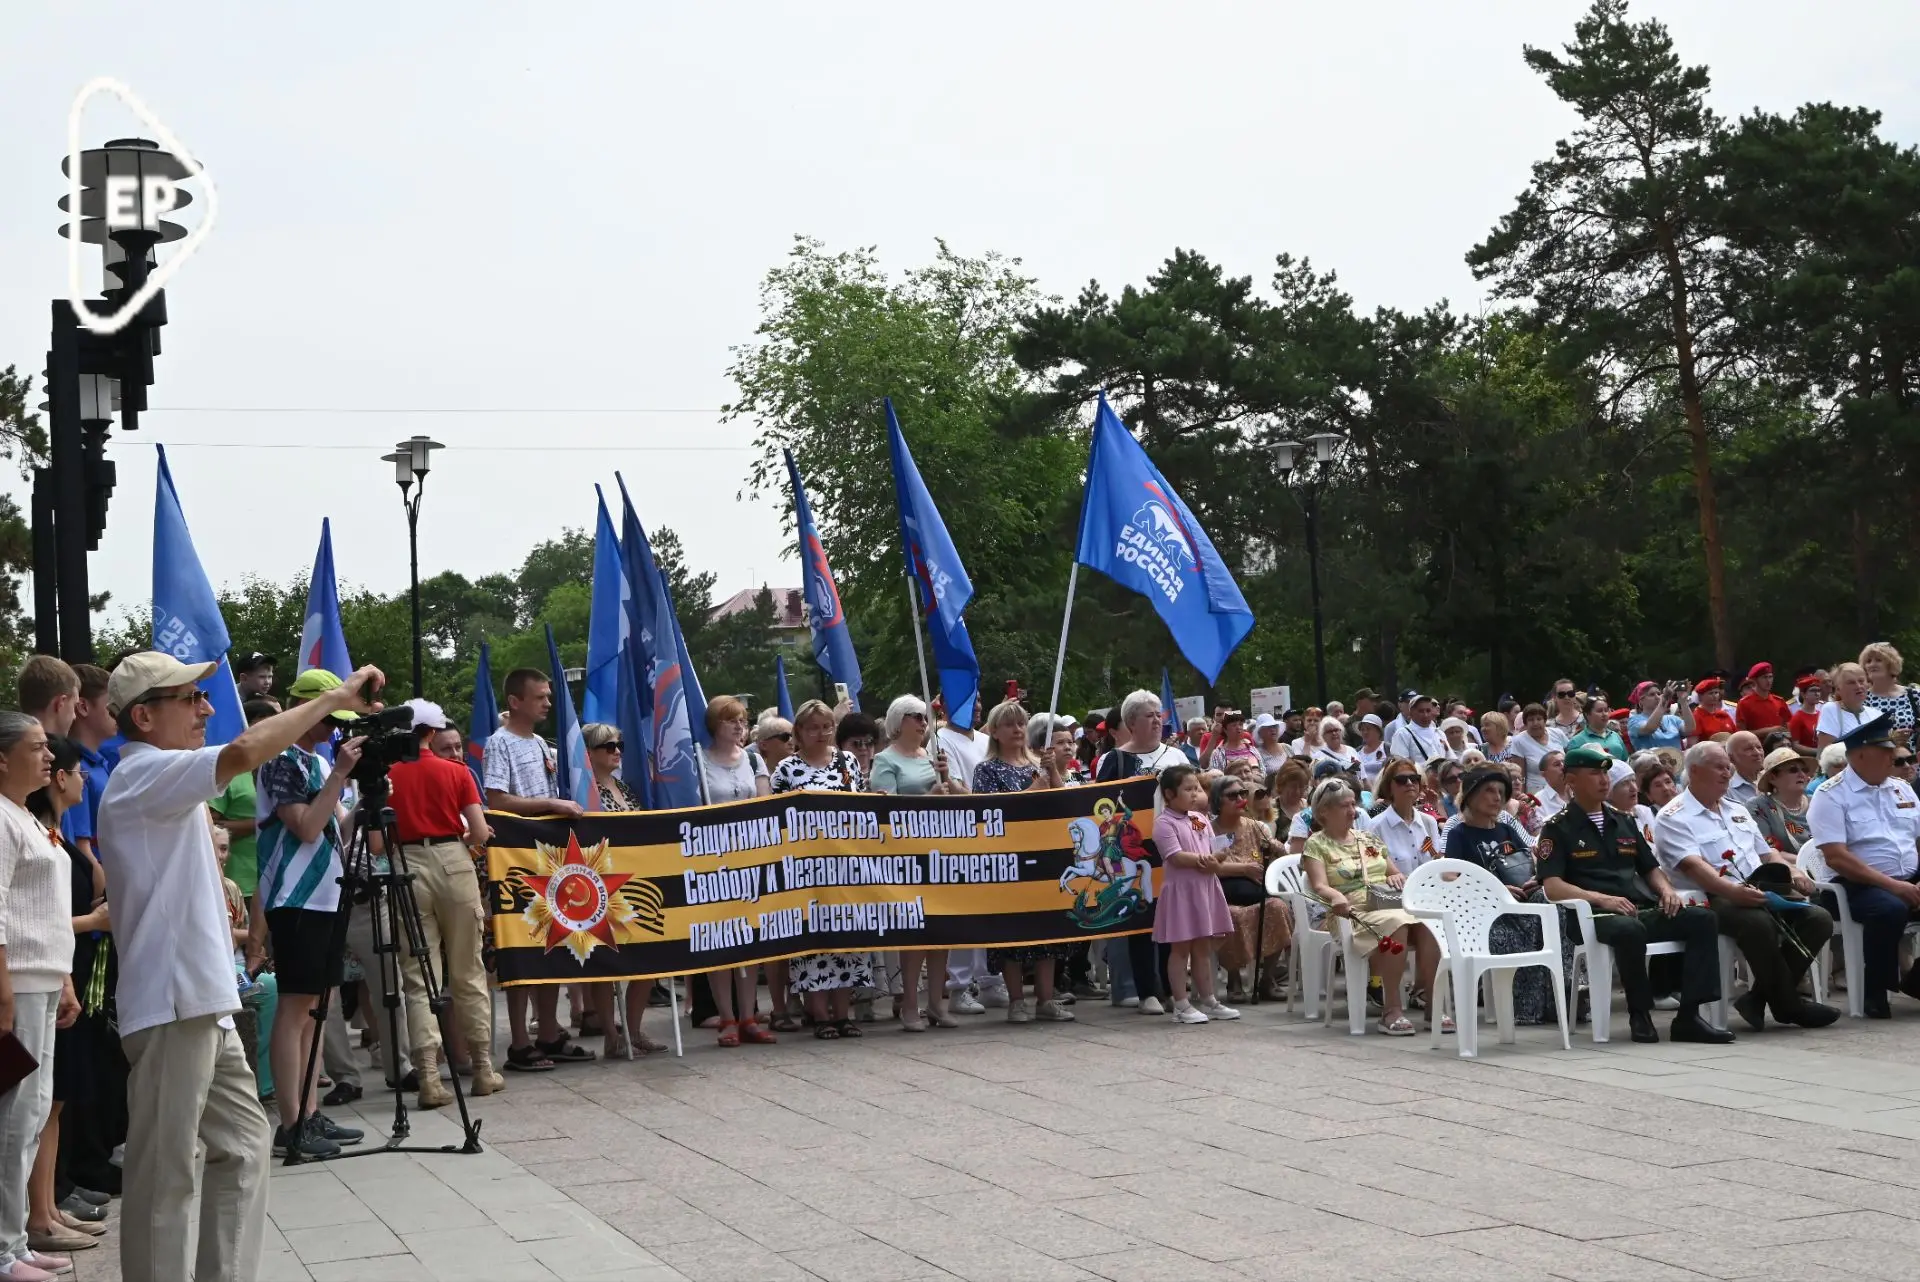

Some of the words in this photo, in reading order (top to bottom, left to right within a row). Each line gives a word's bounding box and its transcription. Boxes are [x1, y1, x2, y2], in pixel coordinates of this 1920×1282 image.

[1116, 541, 1178, 604] РОССИЯ
[1120, 524, 1184, 592] ЕДИНАЯ
[679, 815, 781, 857] Защитники
[785, 806, 885, 843] Отечества,
[889, 808, 977, 840] стоявшие
[983, 808, 1005, 837] за
[590, 885, 606, 923] ВОЙНА
[684, 863, 760, 905] Свободу
[766, 862, 778, 894] и
[781, 854, 922, 889] Независимость
[928, 849, 1019, 884] Отечества
[689, 913, 754, 953] память
[759, 906, 804, 941] ваша
[807, 896, 925, 936] бессмертна!
